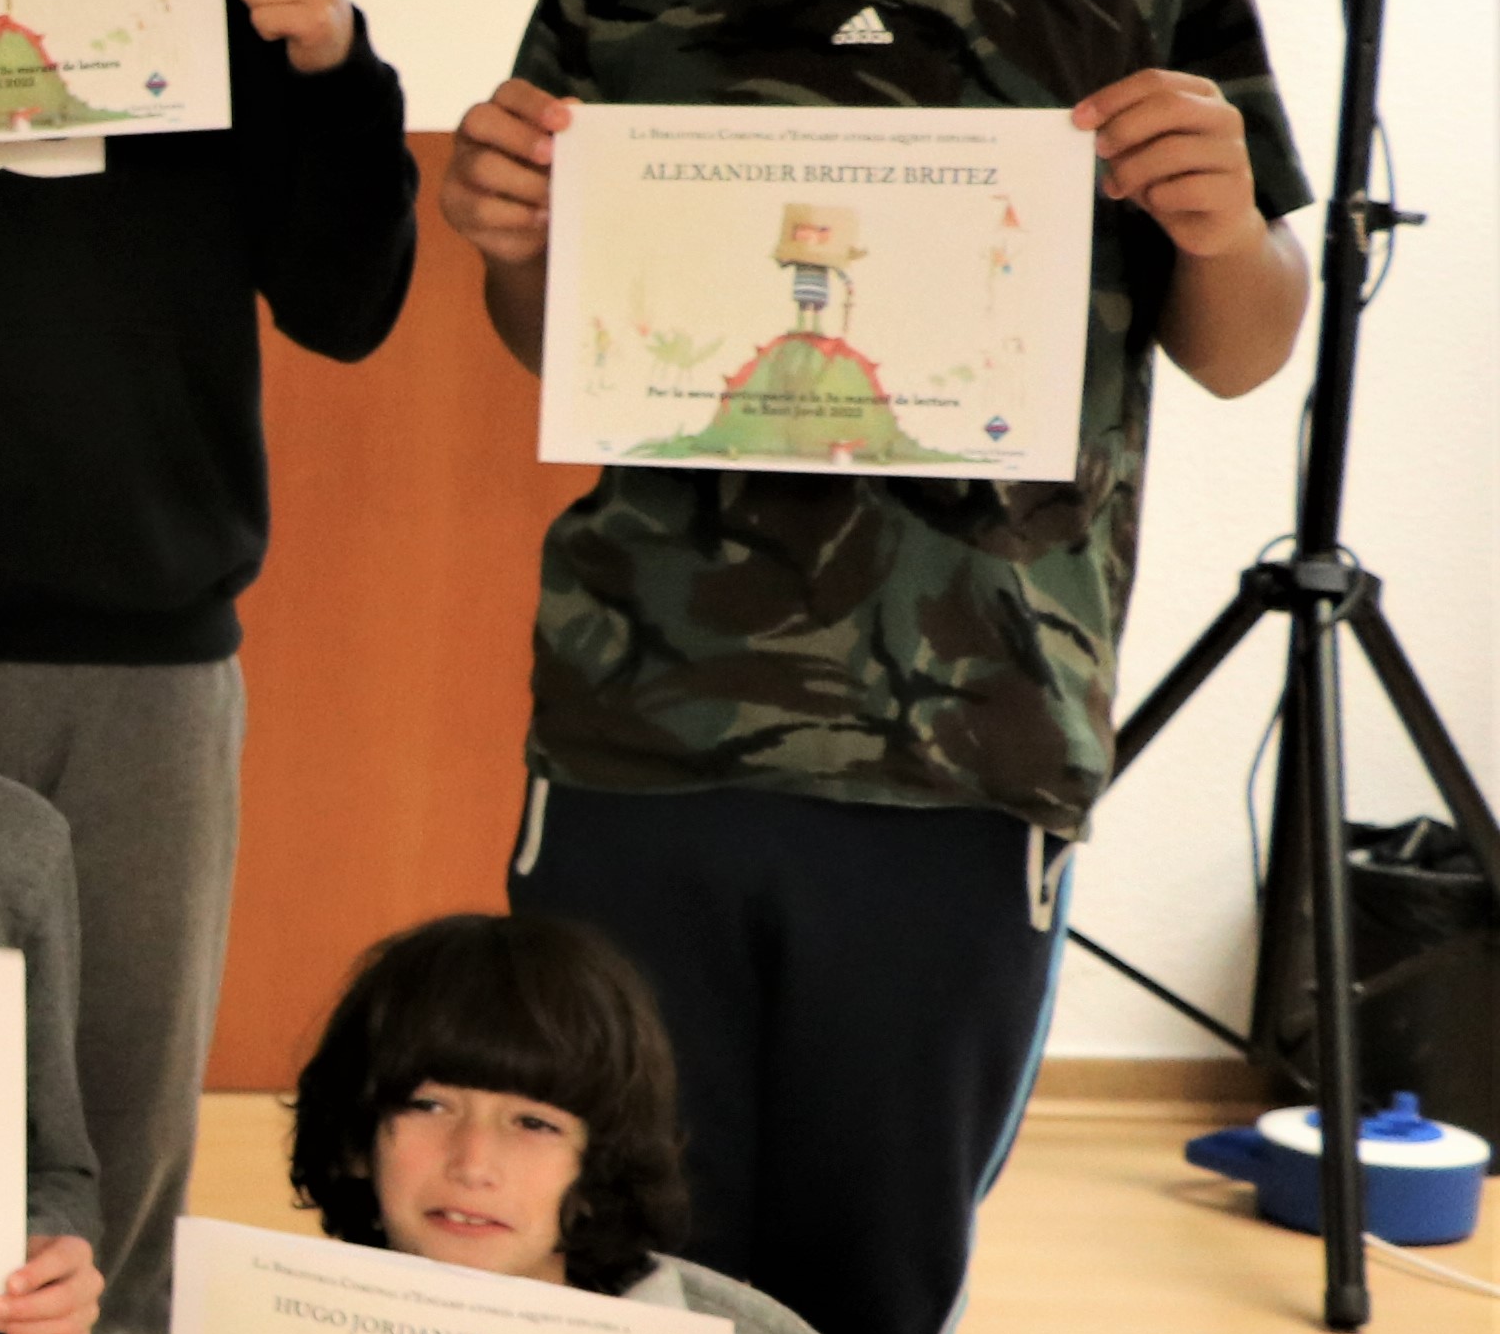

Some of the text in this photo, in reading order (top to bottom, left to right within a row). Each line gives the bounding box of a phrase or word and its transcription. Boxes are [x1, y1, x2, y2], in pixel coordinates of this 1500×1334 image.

[643, 163, 999, 185] ALEXANDER BRITEZ BRITEZ
[275, 1295, 347, 1327] HUGO
